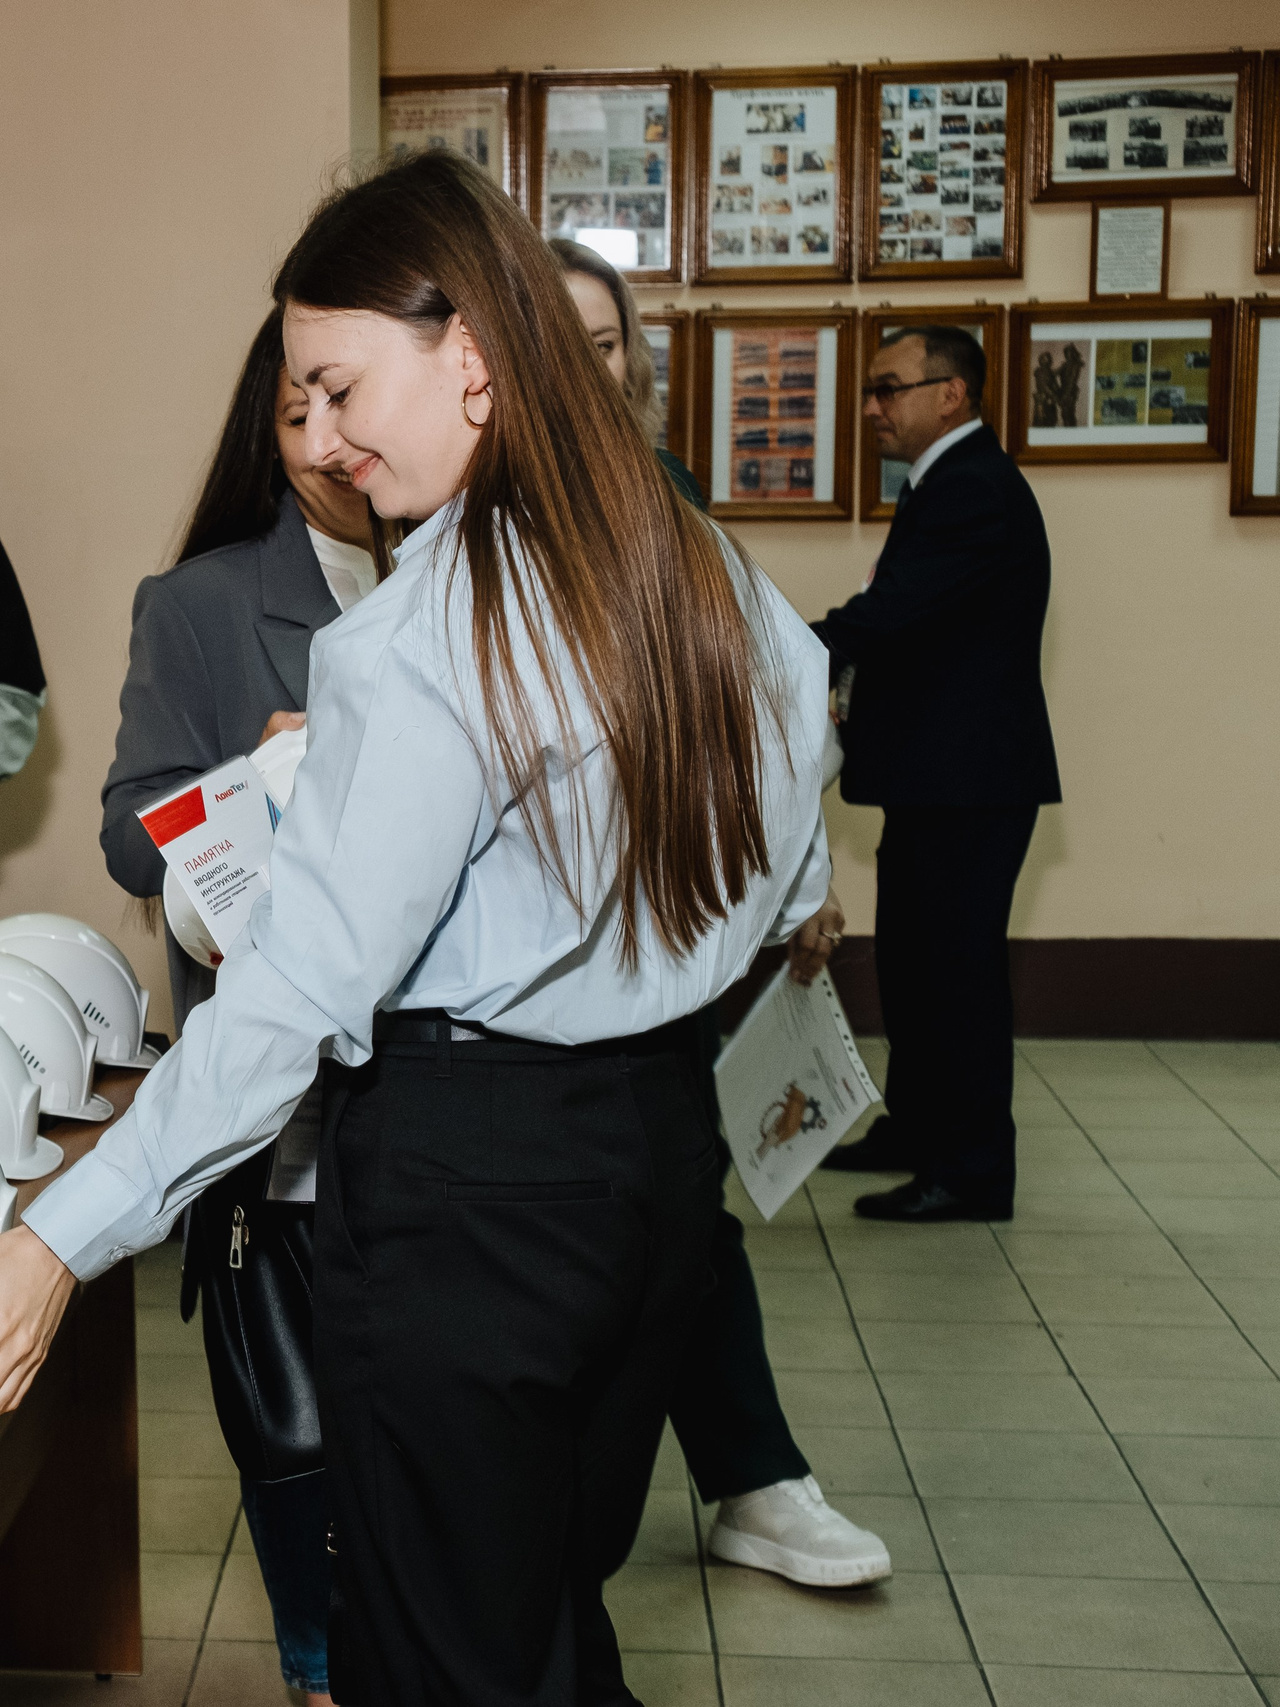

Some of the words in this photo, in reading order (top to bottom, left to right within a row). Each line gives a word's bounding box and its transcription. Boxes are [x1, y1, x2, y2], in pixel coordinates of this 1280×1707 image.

[183, 839, 235, 874] ПАМЯТКА
[193, 862, 229, 887] ВВОДНОГО
[200, 867, 247, 898] ИНСТРУКТАЖА
